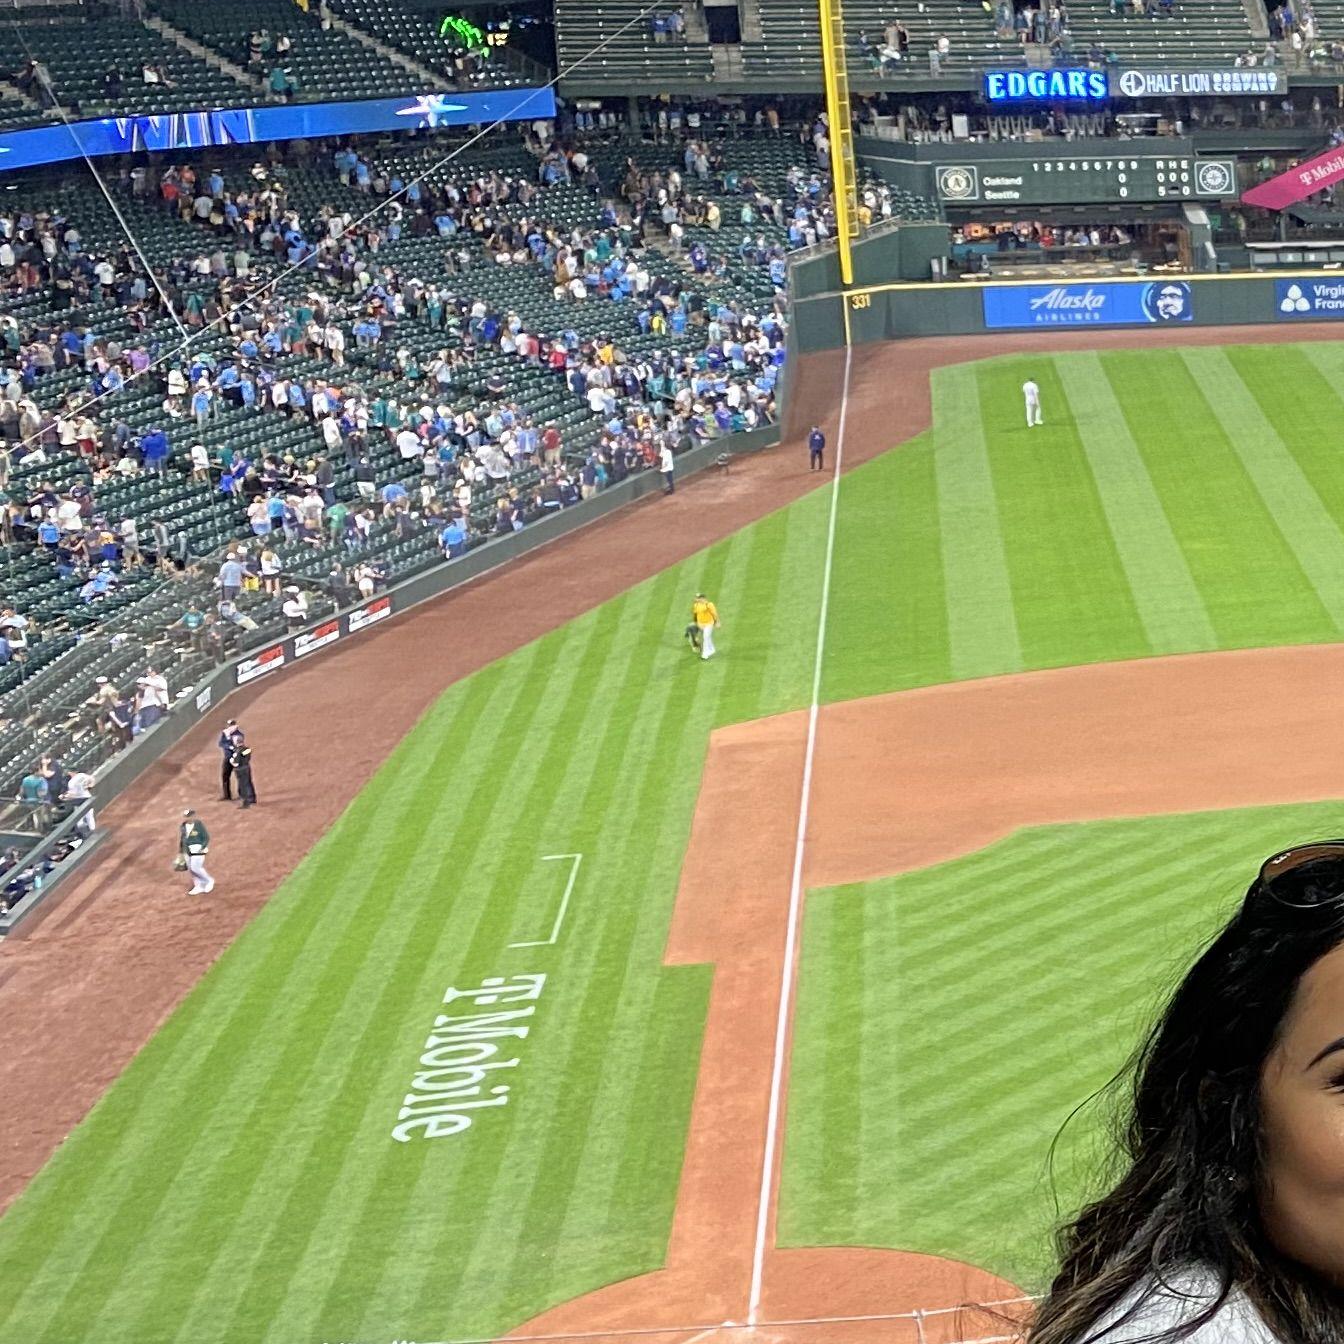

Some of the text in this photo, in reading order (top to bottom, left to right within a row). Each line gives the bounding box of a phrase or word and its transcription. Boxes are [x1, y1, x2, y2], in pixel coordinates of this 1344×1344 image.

[1146, 73, 1180, 93] HALF
[1182, 73, 1210, 93] LION
[851, 295, 870, 309] 331
[1029, 288, 1106, 311] Alaska
[1035, 312, 1100, 322] AIRLINES
